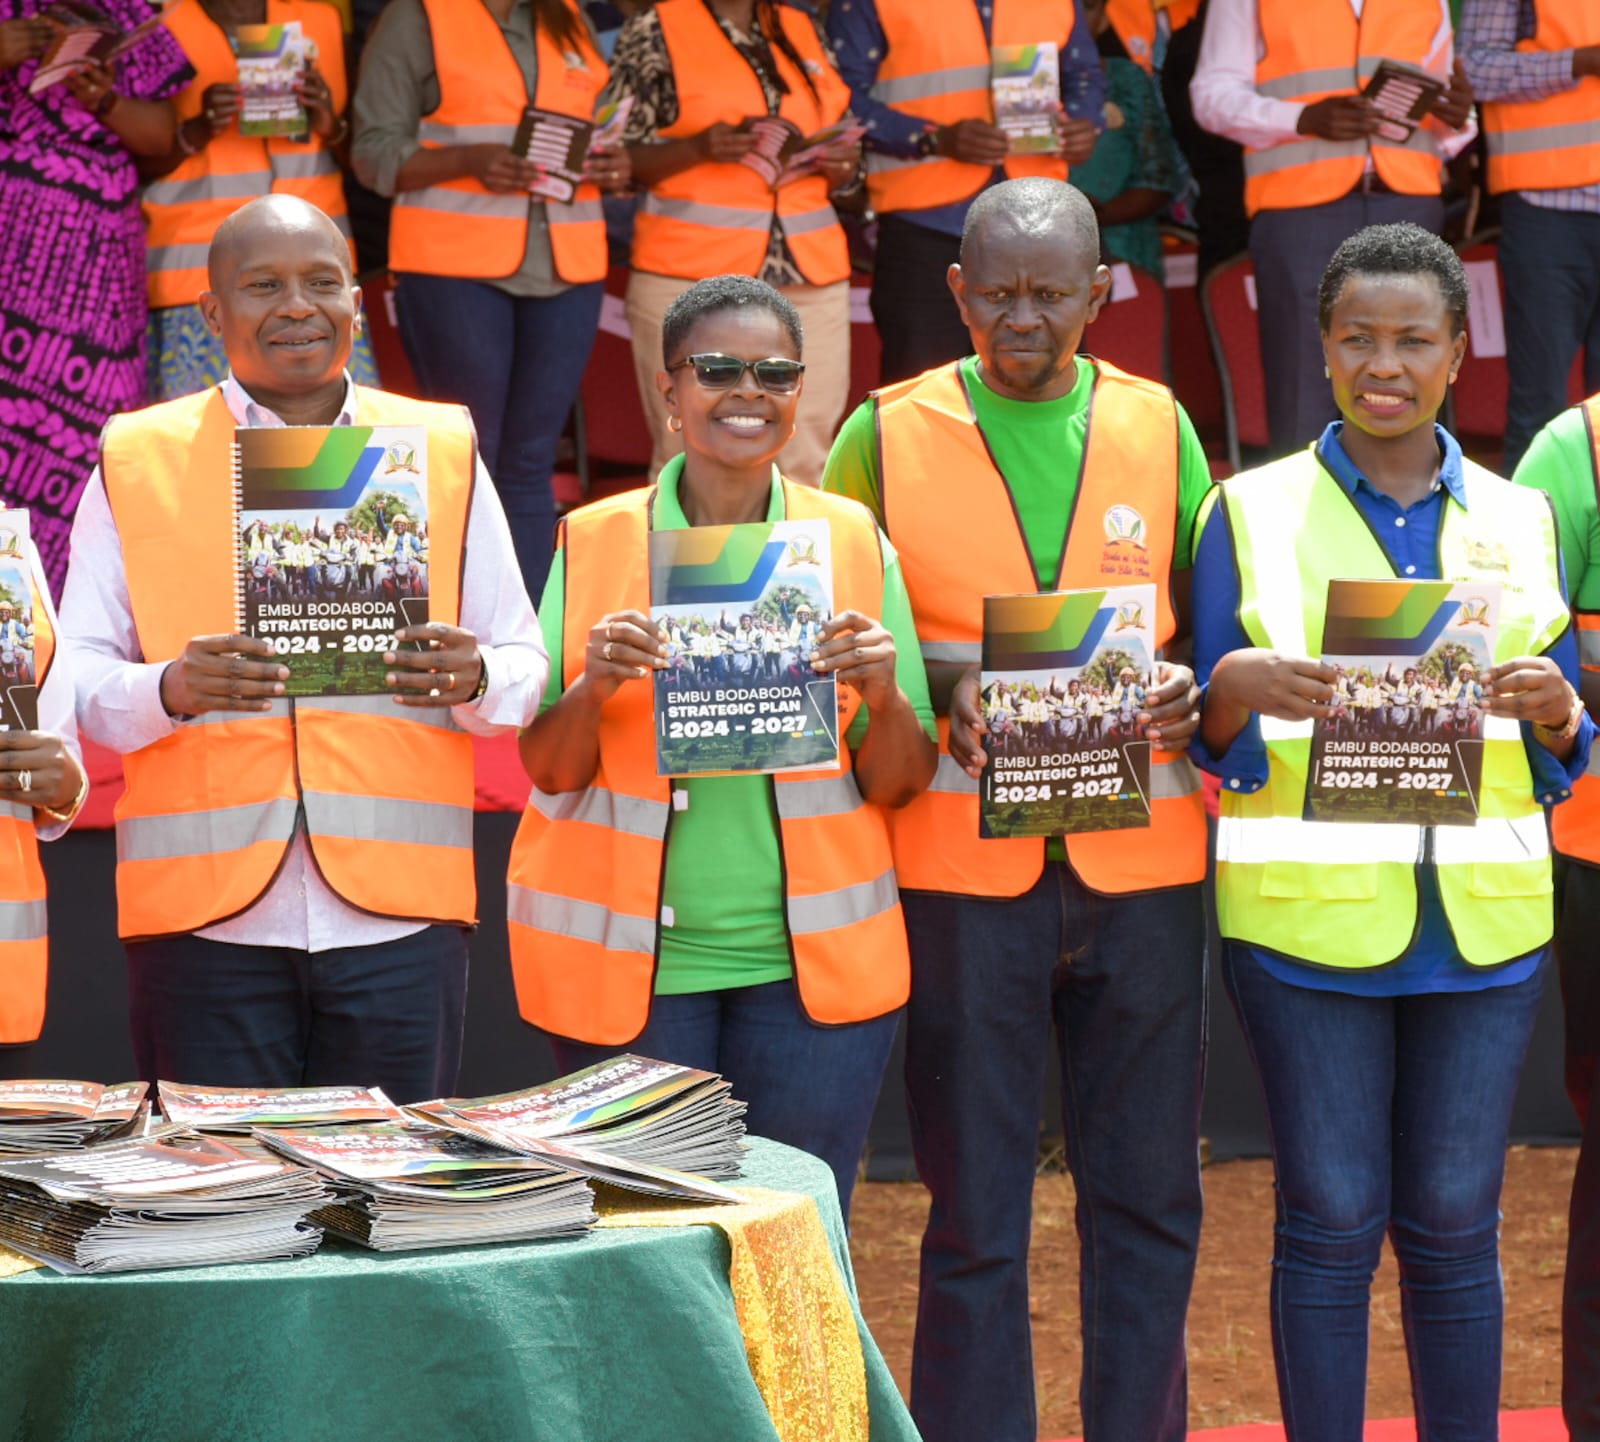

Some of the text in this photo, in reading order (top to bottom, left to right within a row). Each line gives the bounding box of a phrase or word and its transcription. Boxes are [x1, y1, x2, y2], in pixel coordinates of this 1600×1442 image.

[258, 602, 396, 617] EMBU BODABODA
[258, 617, 394, 632] STRATEGIC PLAN
[343, 634, 400, 652] 2027
[667, 686, 802, 703] EMBU BODABODA
[668, 700, 800, 718] STRATEGIC PLAN
[669, 720, 730, 738] 2024
[751, 715, 808, 734] 2027
[1324, 741, 1452, 755] EMBU BODABODA
[994, 748, 1120, 769] EMBU BODABODA
[1323, 755, 1448, 769] STRATEGIC PLAN
[994, 762, 1118, 783] STRATEGIC PLAN
[1321, 771, 1378, 789] 2024
[1397, 772, 1453, 790] 2027
[994, 785, 1052, 803] 2024
[1071, 777, 1124, 798] 2027
